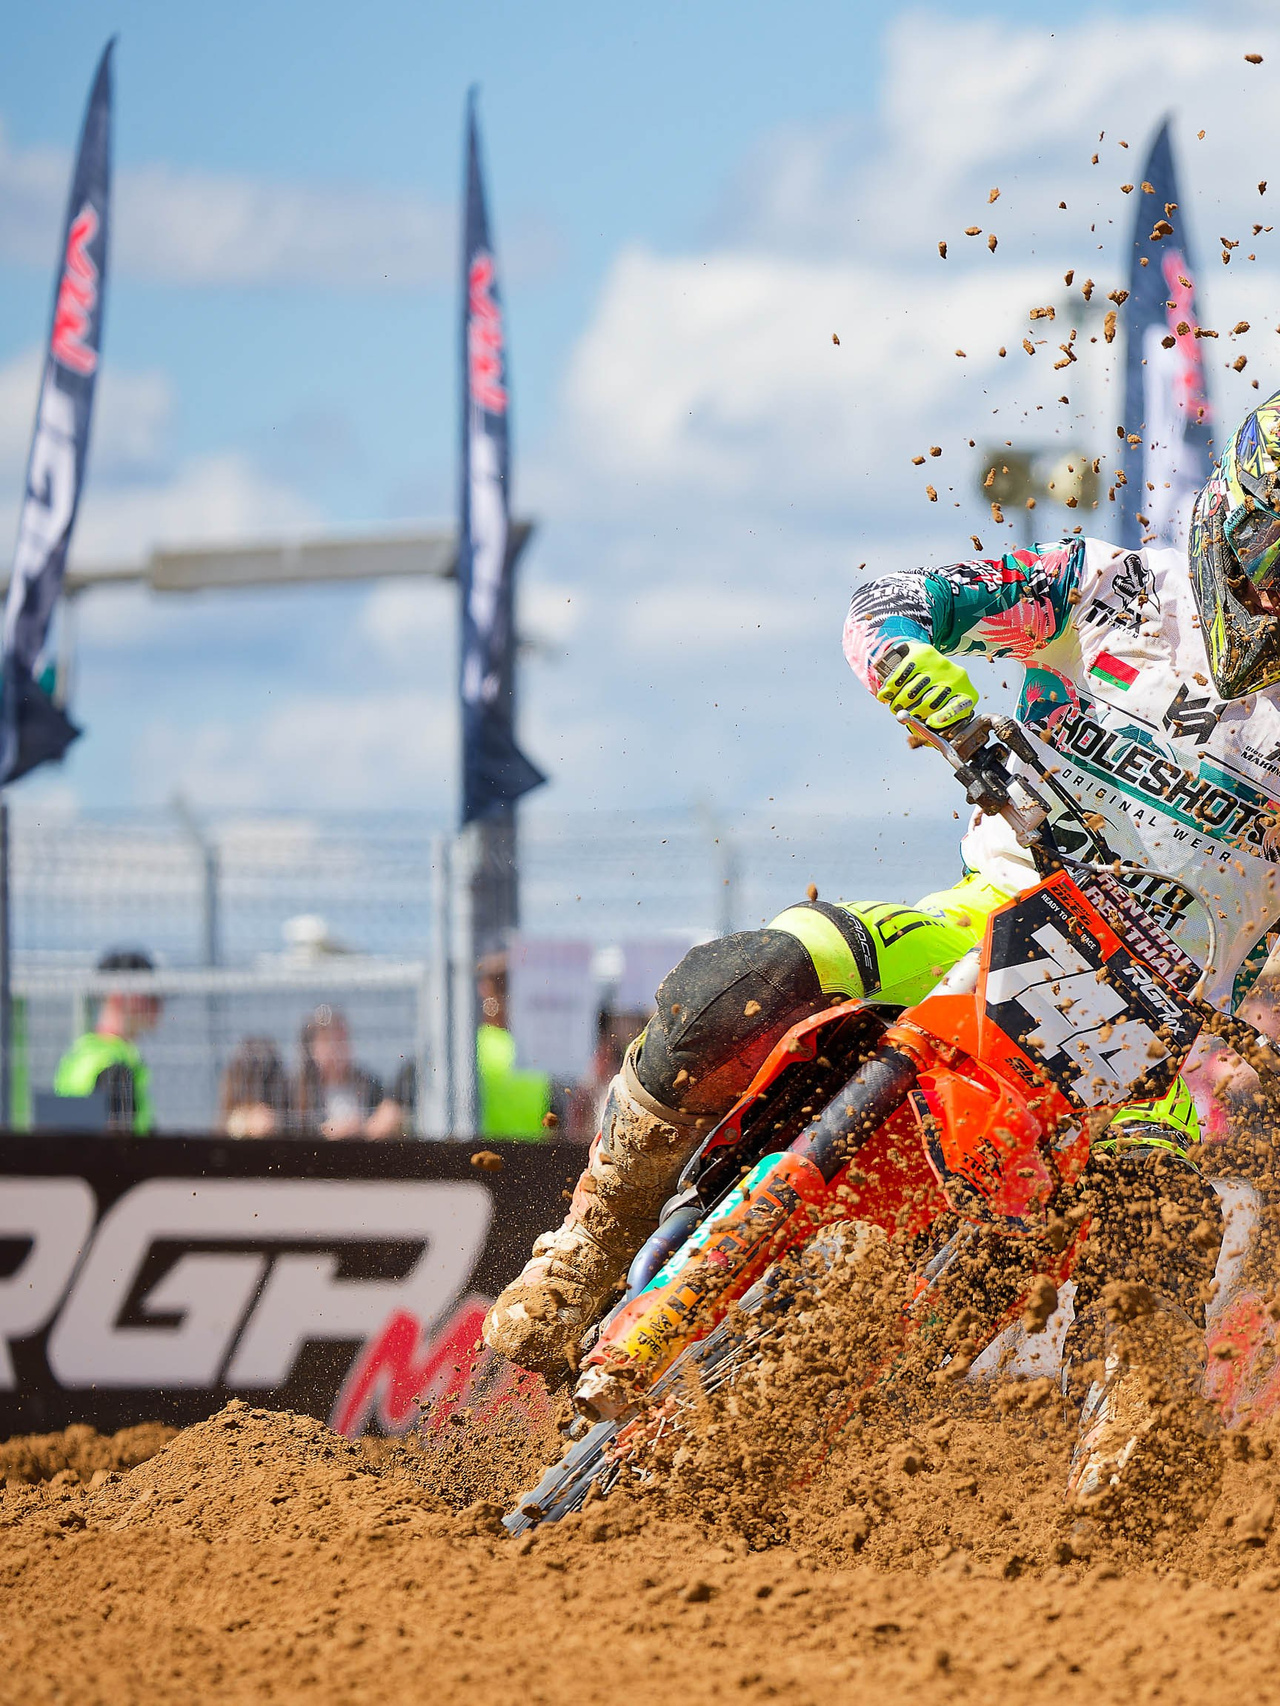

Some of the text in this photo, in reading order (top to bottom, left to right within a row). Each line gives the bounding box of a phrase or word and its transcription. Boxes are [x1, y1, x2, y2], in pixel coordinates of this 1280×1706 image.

[1057, 708, 1277, 846] HOLESHOTS
[1061, 767, 1231, 862] ORIGINAL WEAR
[1040, 892, 1097, 950] READY TO RACE
[1050, 886, 1093, 927] OLEG
[1085, 886, 1184, 990] RENTHAL
[1097, 872, 1197, 978] RENTHAL
[986, 922, 1173, 1108] 744
[1122, 965, 1184, 1021] RGP
